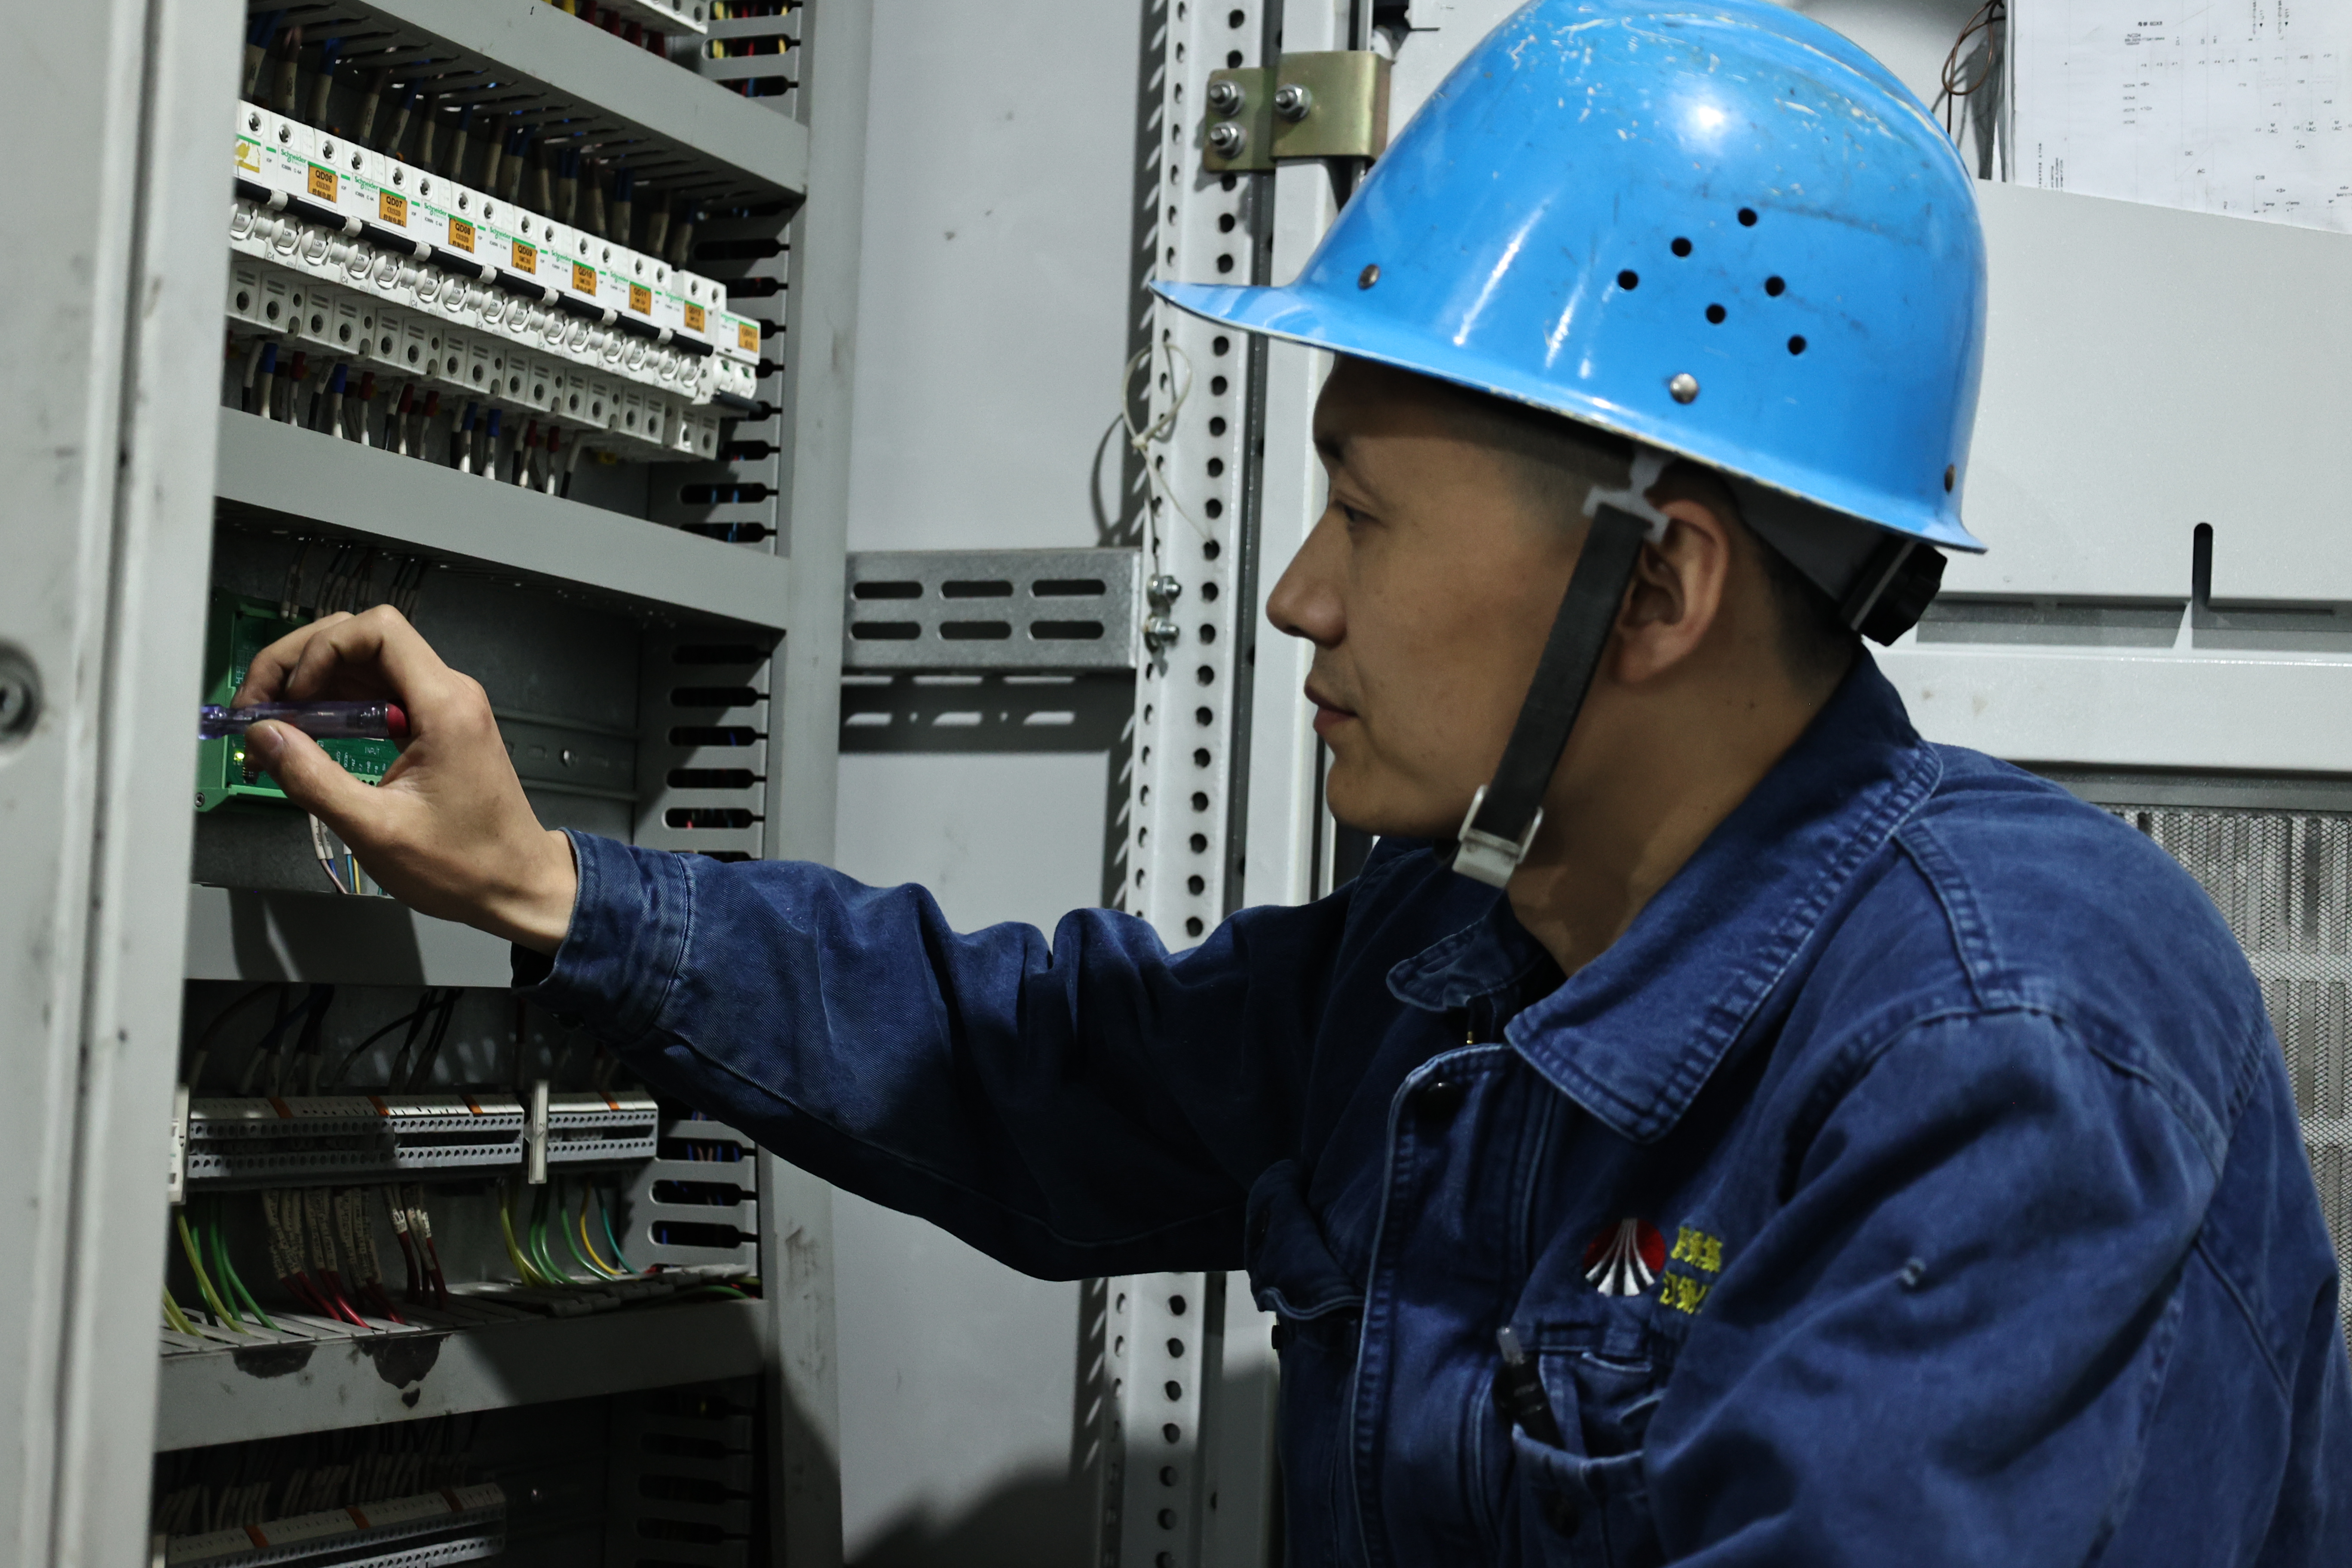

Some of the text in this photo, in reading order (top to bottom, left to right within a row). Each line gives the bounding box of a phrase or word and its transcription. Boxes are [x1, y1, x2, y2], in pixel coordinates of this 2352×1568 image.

[281, 149, 307, 163] Schneider
[315, 170, 332, 183] QD06
[355, 176, 379, 190] Schneider
[386, 196, 402, 208] QD07
[424, 202, 447, 215] Schneider
[455, 223, 471, 235] QD08
[490, 227, 511, 239] Schneider
[518, 245, 532, 257] QD09
